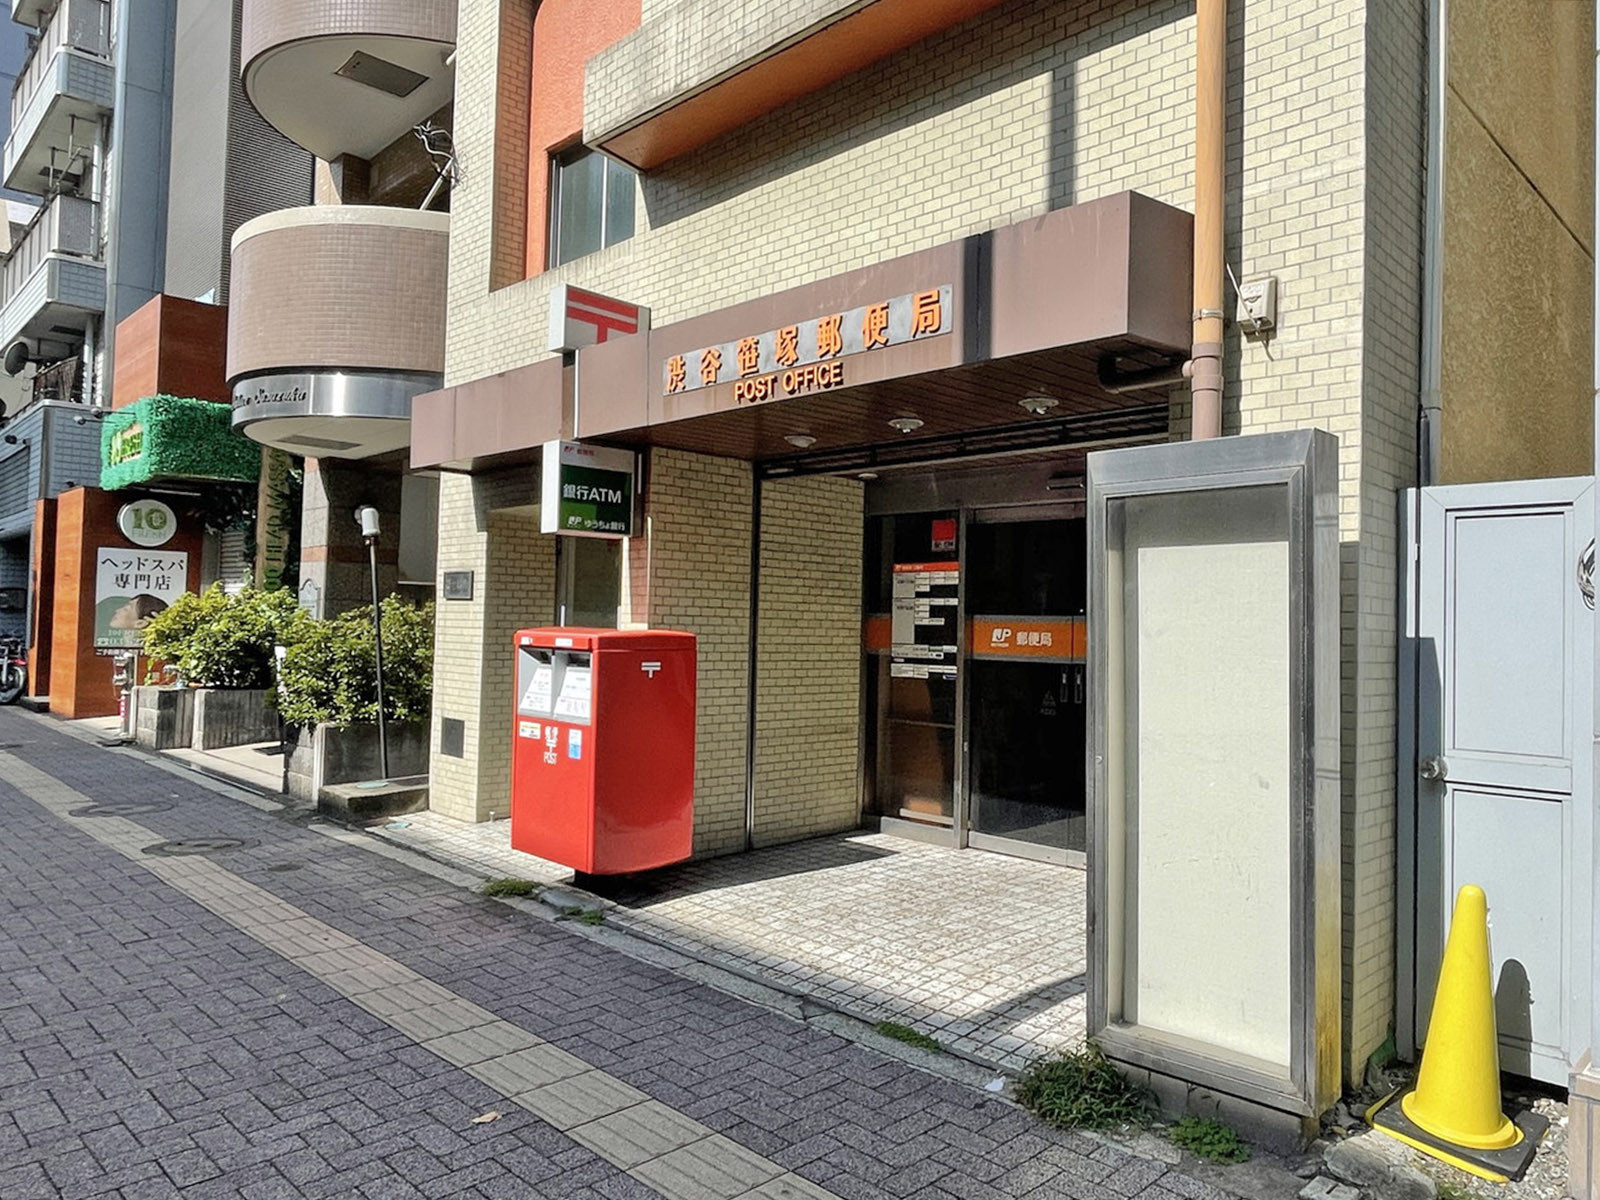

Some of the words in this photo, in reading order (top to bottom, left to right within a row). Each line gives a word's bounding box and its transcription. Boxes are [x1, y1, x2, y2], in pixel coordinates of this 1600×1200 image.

[666, 287, 943, 393] 渋谷笹塚郵便局
[734, 375, 777, 402] POST
[782, 361, 845, 394] OFFICE
[563, 483, 622, 504] 銀行ATM
[132, 508, 168, 530] 10
[584, 520, 625, 531] ゆうちょ銀行
[114, 573, 172, 590] 専門店
[1016, 631, 1052, 647] 郵便局
[543, 751, 558, 765] POST
